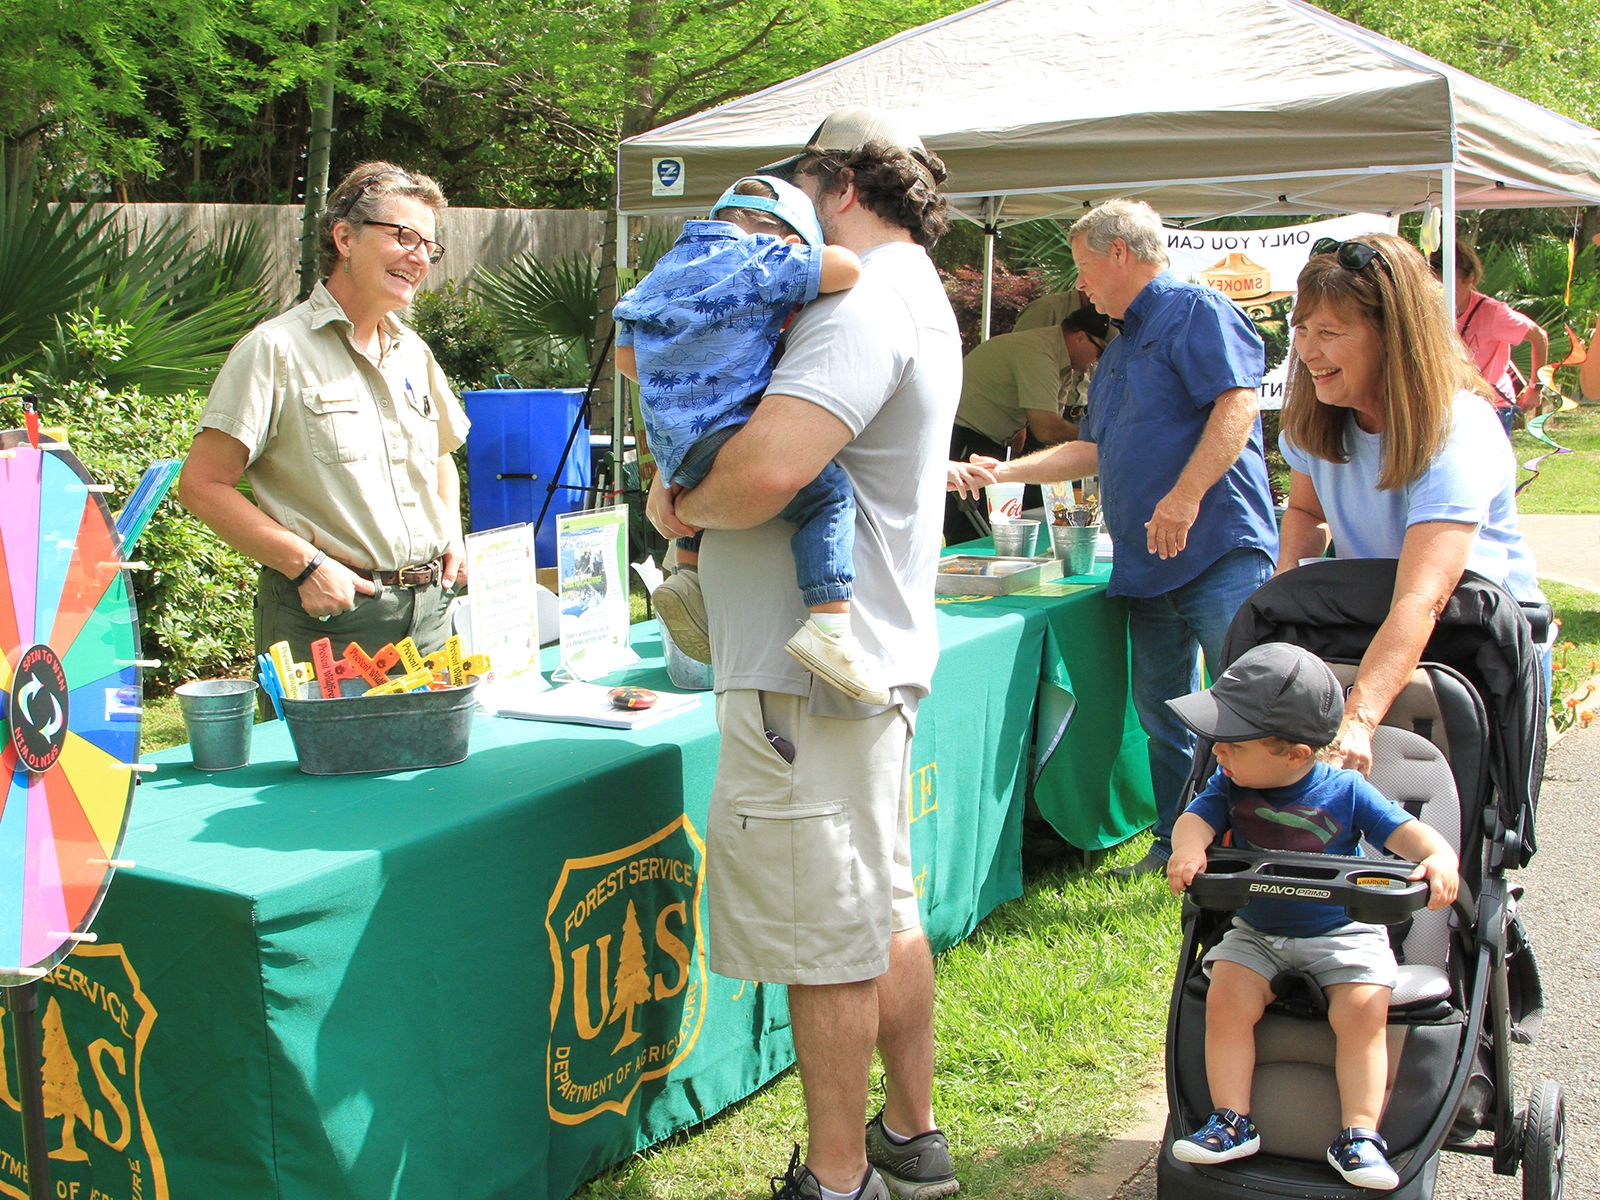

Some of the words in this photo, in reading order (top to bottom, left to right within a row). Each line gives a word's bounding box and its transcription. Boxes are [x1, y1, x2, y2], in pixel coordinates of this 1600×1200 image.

[317, 642, 330, 669] Prevent
[349, 647, 371, 672] Prevent
[402, 642, 419, 668] Prevent
[450, 640, 459, 666] Prevent
[22, 649, 41, 673] SPIN
[41, 649, 52, 665] TO
[52, 660, 66, 692] WIN
[14, 726, 29, 759] WIN
[41, 743, 59, 768] SPIN
[28, 753, 40, 768] TO
[1249, 883, 1295, 895] BRAVO
[1297, 888, 1331, 898] PRIMO
[1361, 877, 1390, 886] WARNING
[564, 865, 627, 943] FOREST
[628, 857, 693, 888] SERVICE
[554, 1046, 614, 1103] DEPARTMENT
[616, 1061, 632, 1084] OF
[634, 979, 699, 1073] AGRICULTURE
[56, 1180, 80, 1200] OF
